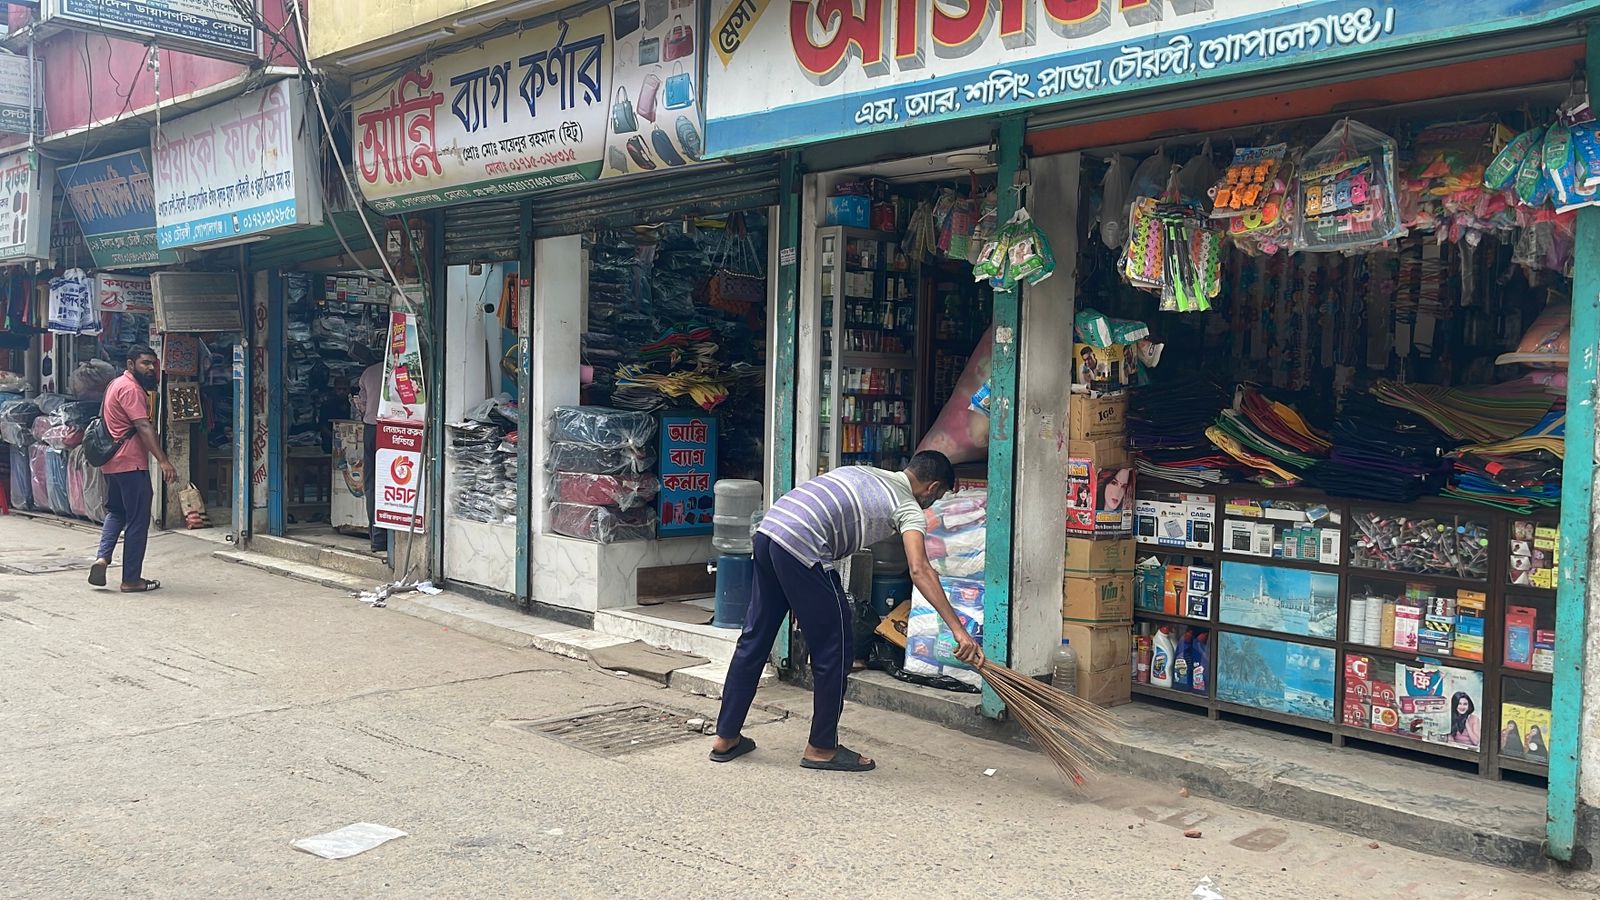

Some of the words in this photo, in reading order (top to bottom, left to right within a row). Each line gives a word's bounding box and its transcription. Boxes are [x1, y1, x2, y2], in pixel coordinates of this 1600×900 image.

[451, 60, 512, 133] ব্যাগ
[519, 21, 605, 118] কর্ণার
[854, 97, 899, 124] এম,
[904, 86, 961, 117] আর,
[964, 69, 1036, 106] শপিং
[1108, 34, 1197, 87] চৌরঙ্গী,
[462, 143, 480, 161] প্রোঃ
[481, 140, 498, 158] মোঃ
[527, 128, 555, 148] রহমান
[668, 419, 708, 443] আন্নি
[669, 448, 705, 467] ব্যাগ
[384, 485, 417, 504] নগদ
[1101, 581, 1118, 601] Vim
[1412, 671, 1430, 689] ফ্রি
